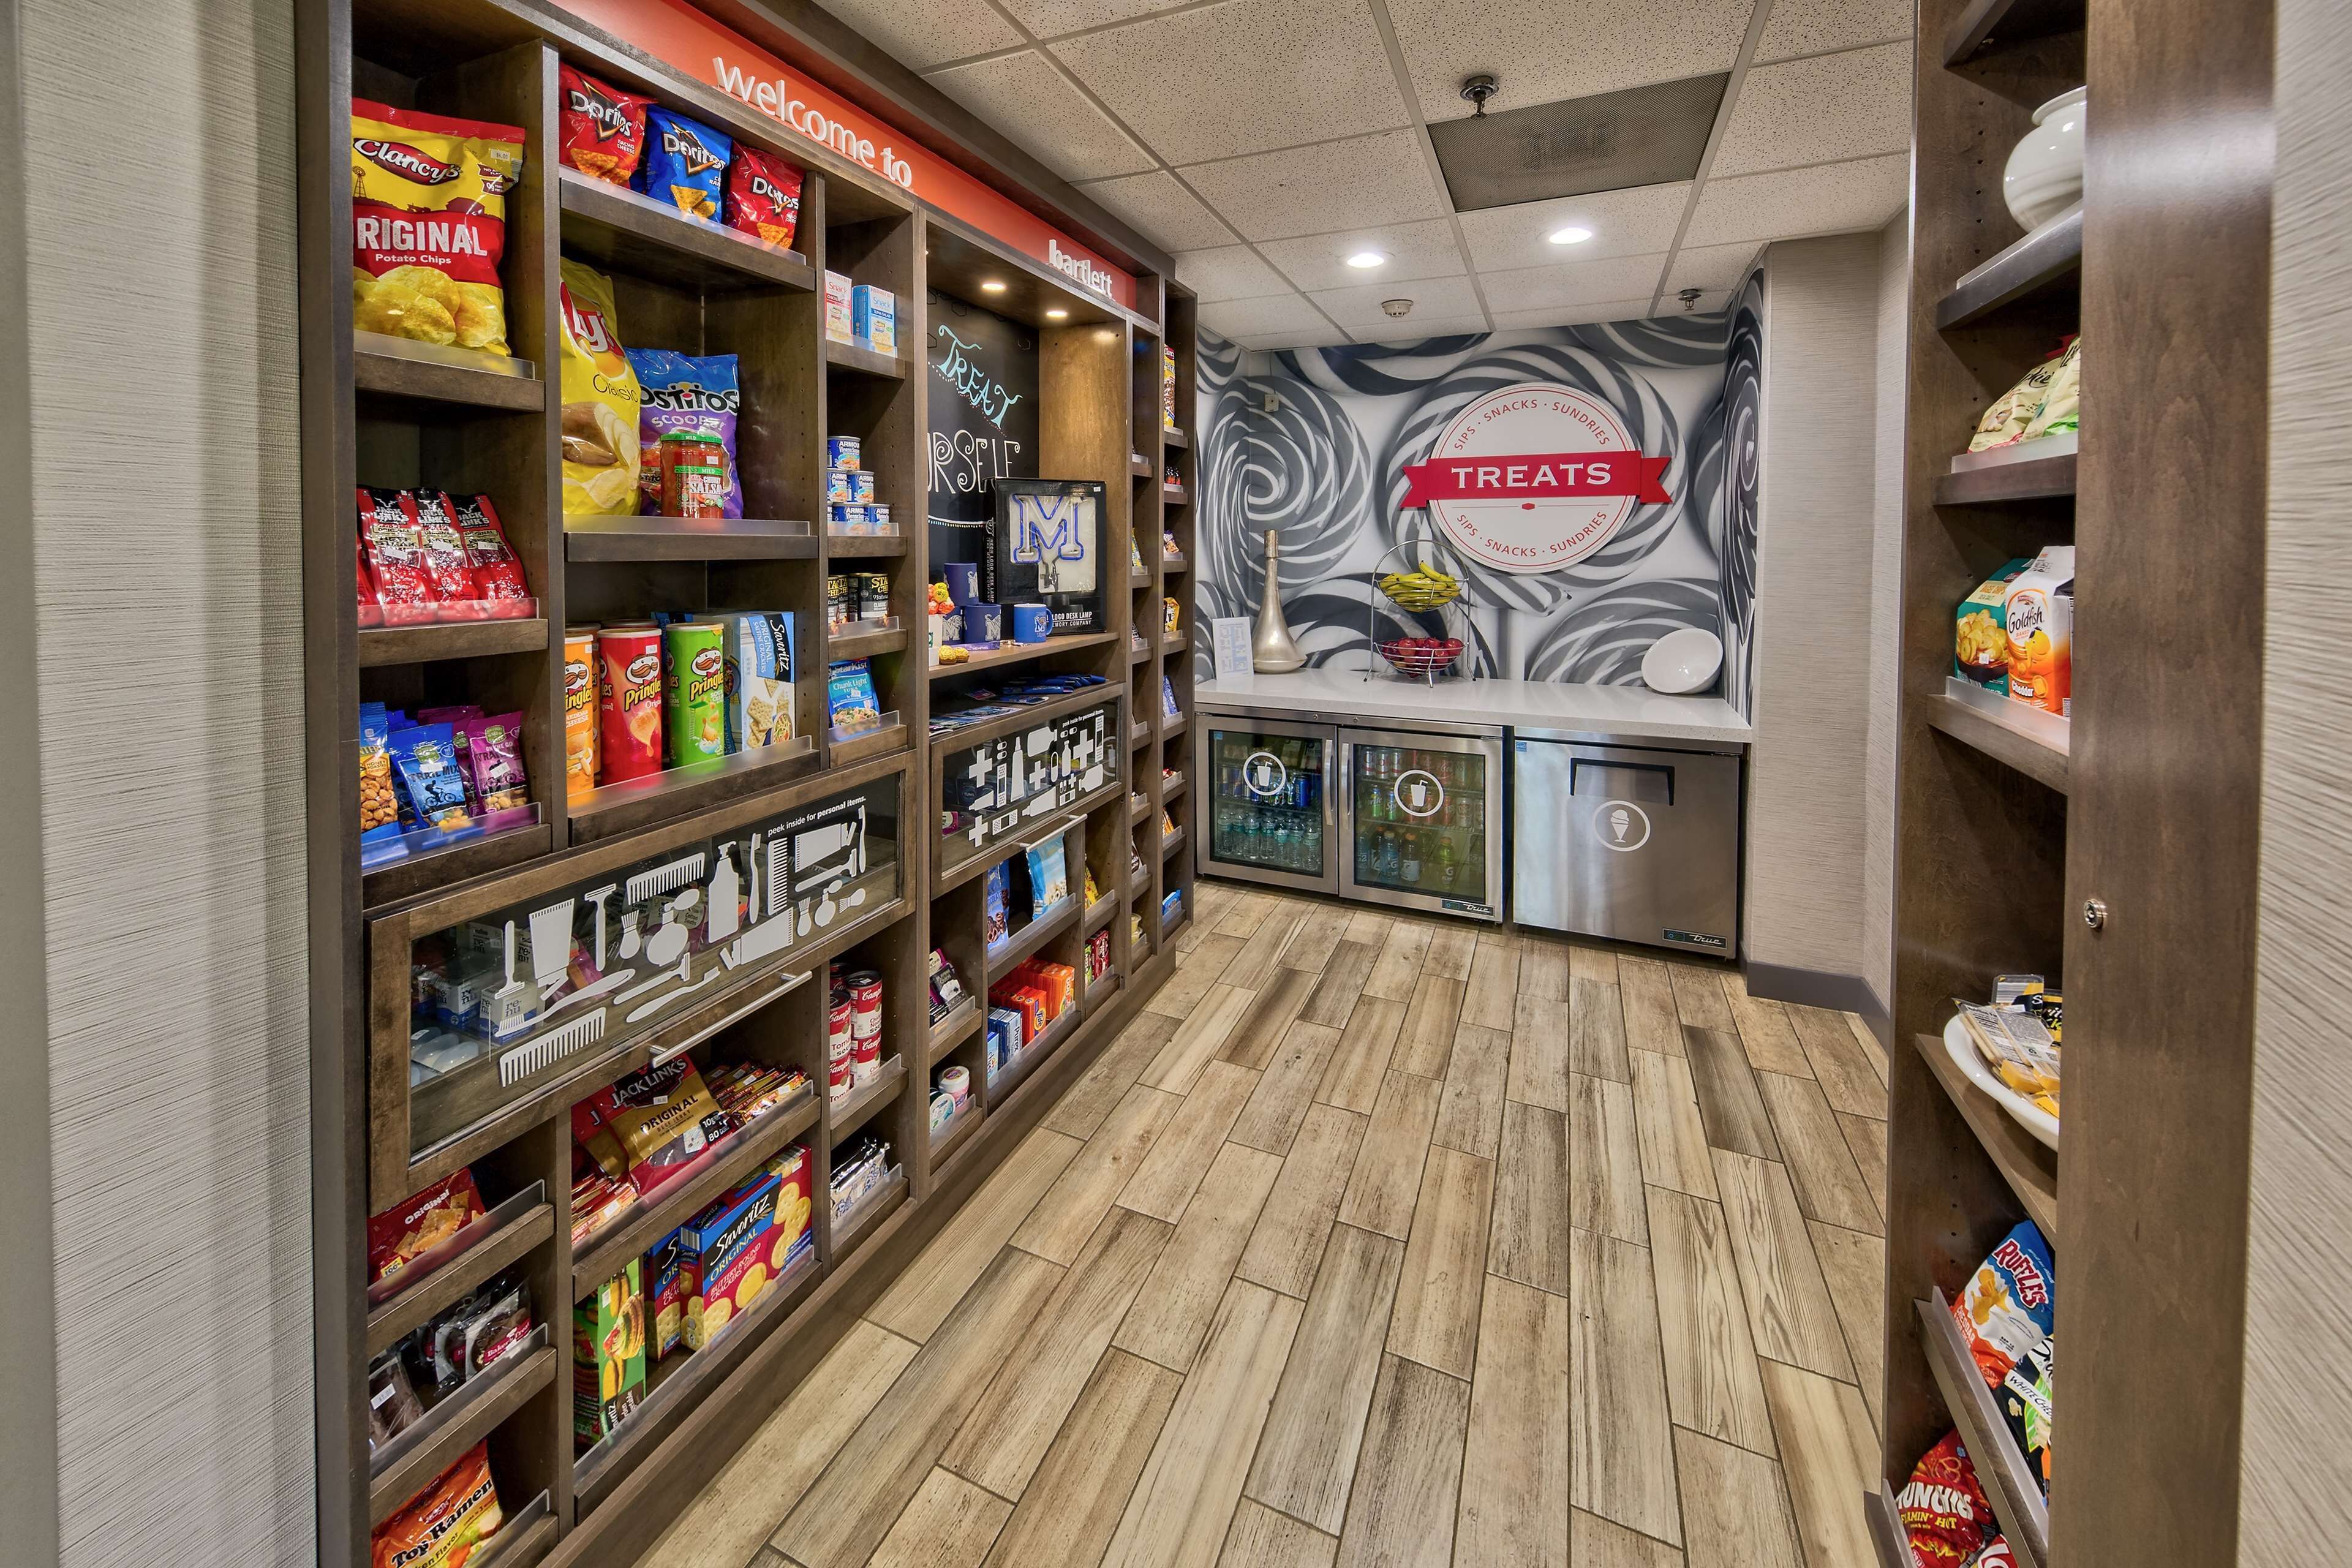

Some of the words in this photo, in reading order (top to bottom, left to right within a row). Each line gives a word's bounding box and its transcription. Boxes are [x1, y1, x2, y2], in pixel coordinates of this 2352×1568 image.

[571, 91, 632, 137] Doritos
[712, 57, 875, 168] Welcome
[880, 147, 912, 187] to
[354, 137, 461, 184] Clancy's
[664, 133, 726, 170] Doritos
[357, 217, 488, 256] RIGINAL
[375, 253, 417, 264] Potato
[420, 255, 451, 265] Chips
[1049, 239, 1113, 298] bartlett
[594, 374, 638, 403] Classic
[938, 325, 1023, 429] TREAT
[1455, 426, 1476, 450] SIPS
[1483, 399, 1537, 422] SNACKS
[1552, 402, 1610, 447] SUNDRIES
[689, 482, 723, 494] SALSA
[1451, 462, 1611, 489] TREATS
[1457, 514, 1479, 537] SIPS
[1485, 538, 1537, 557] SNACKS
[1549, 511, 1607, 554] SUNDRIES
[752, 621, 762, 641] SALTINE
[2009, 606, 2044, 633] Goldfish
[759, 620, 774, 662] ORIGINAL
[770, 619, 790, 673] Savoritz
[2011, 680, 2034, 697] Cheddar
[768, 824, 785, 837] peek
[786, 815, 805, 829] inside
[817, 802, 846, 820] personal
[847, 796, 866, 807] items.
[612, 1079, 650, 1109] JACK
[647, 1057, 687, 1084] LINK'S
[640, 1095, 699, 1133] ORIGINAL
[708, 1130, 720, 1142] 80
[710, 1194, 770, 1266] Savoritz
[710, 1228, 758, 1281] ORIGINAL
[1993, 1239, 2048, 1307] RUFFLES
[2010, 1376, 2037, 1398] WHITE
[392, 1540, 429, 1568] Top
[429, 1478, 494, 1539] Ramen
[435, 1532, 459, 1558] Flavor
